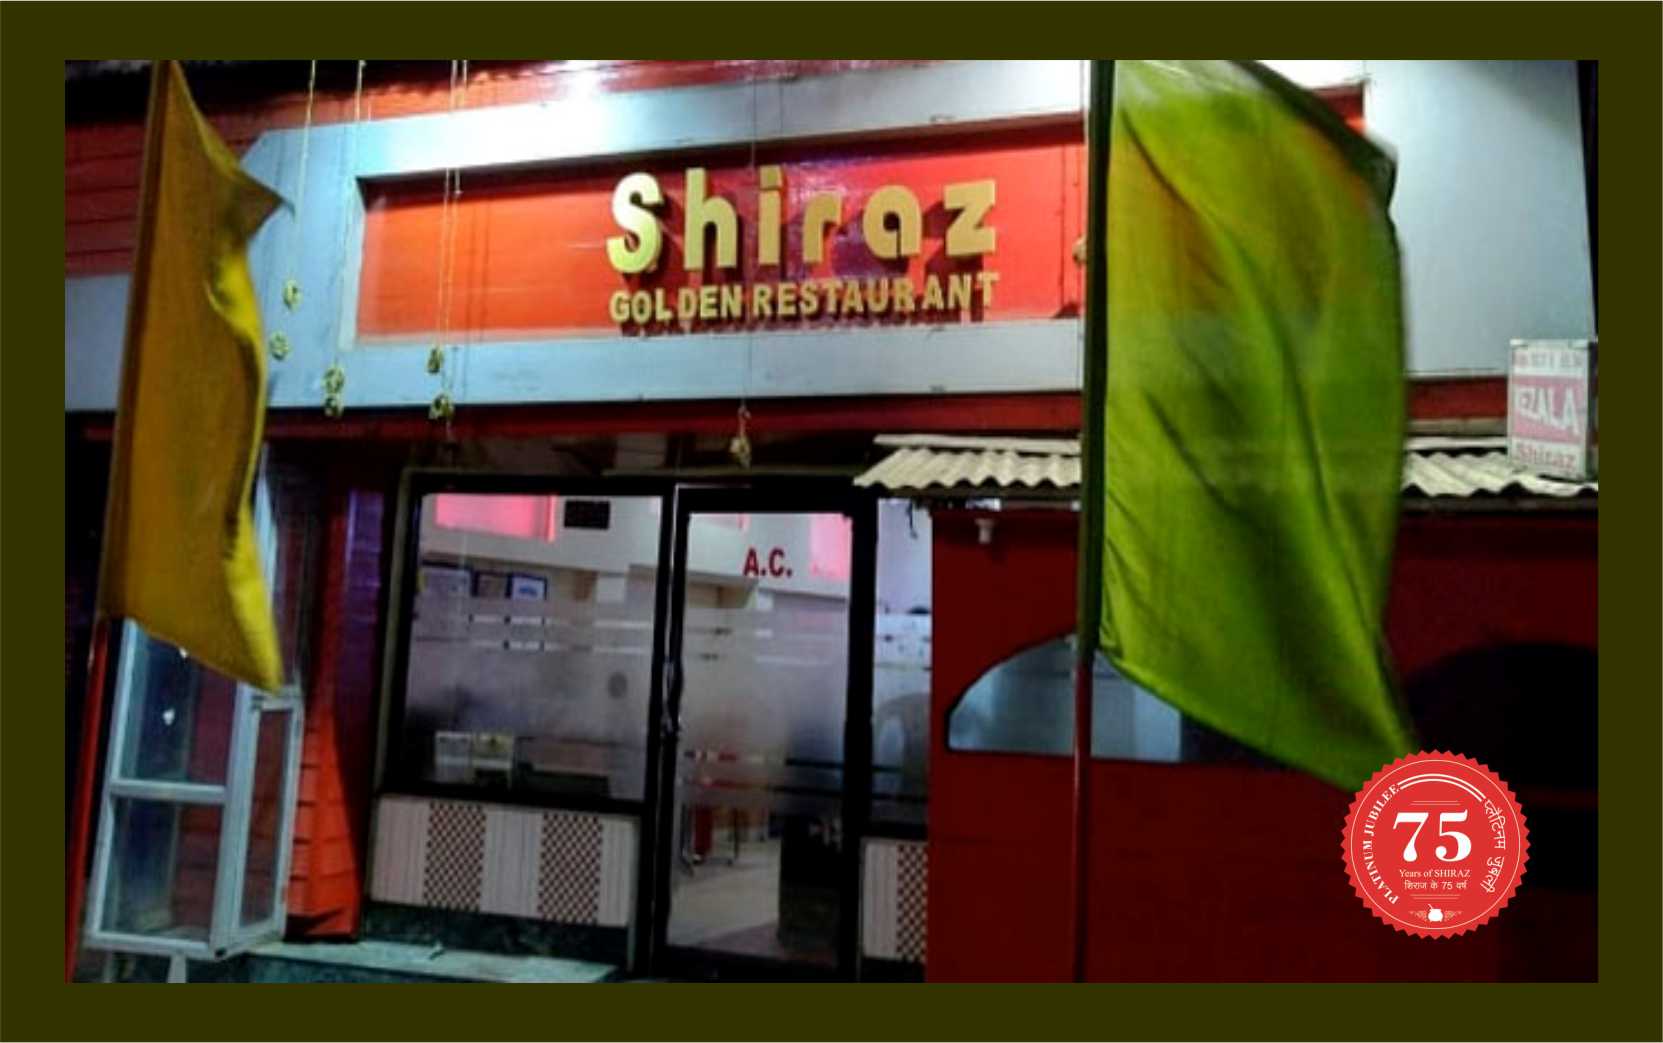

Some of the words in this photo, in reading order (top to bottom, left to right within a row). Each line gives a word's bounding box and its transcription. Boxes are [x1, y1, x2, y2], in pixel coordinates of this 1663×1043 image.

[606, 165, 996, 273] Shiraz
[609, 283, 741, 322] GOLDEN
[752, 272, 999, 319] RESTAURANT
[1516, 442, 1576, 469] Shiraz
[743, 547, 793, 578] A.C.
